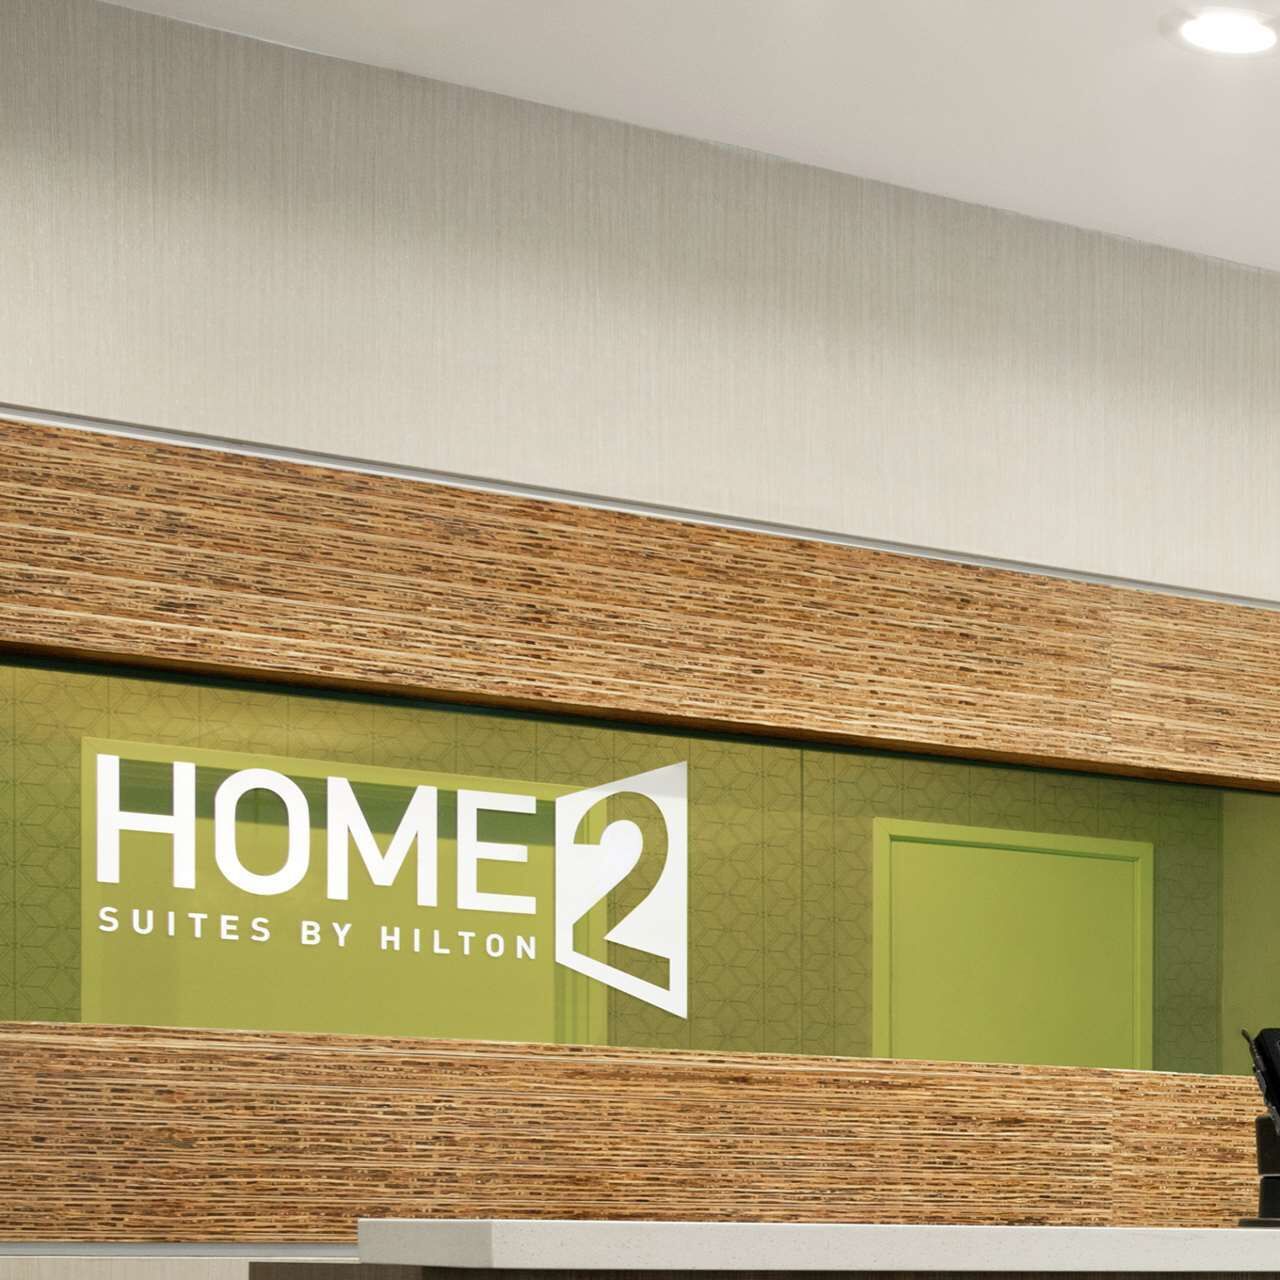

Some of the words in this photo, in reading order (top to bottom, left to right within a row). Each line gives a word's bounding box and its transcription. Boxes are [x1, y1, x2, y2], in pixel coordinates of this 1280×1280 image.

[96, 753, 537, 915] HOME
[566, 778, 677, 1003] 2
[98, 905, 272, 943] SUITES
[301, 920, 352, 947] BY
[381, 925, 537, 960] HILTON
